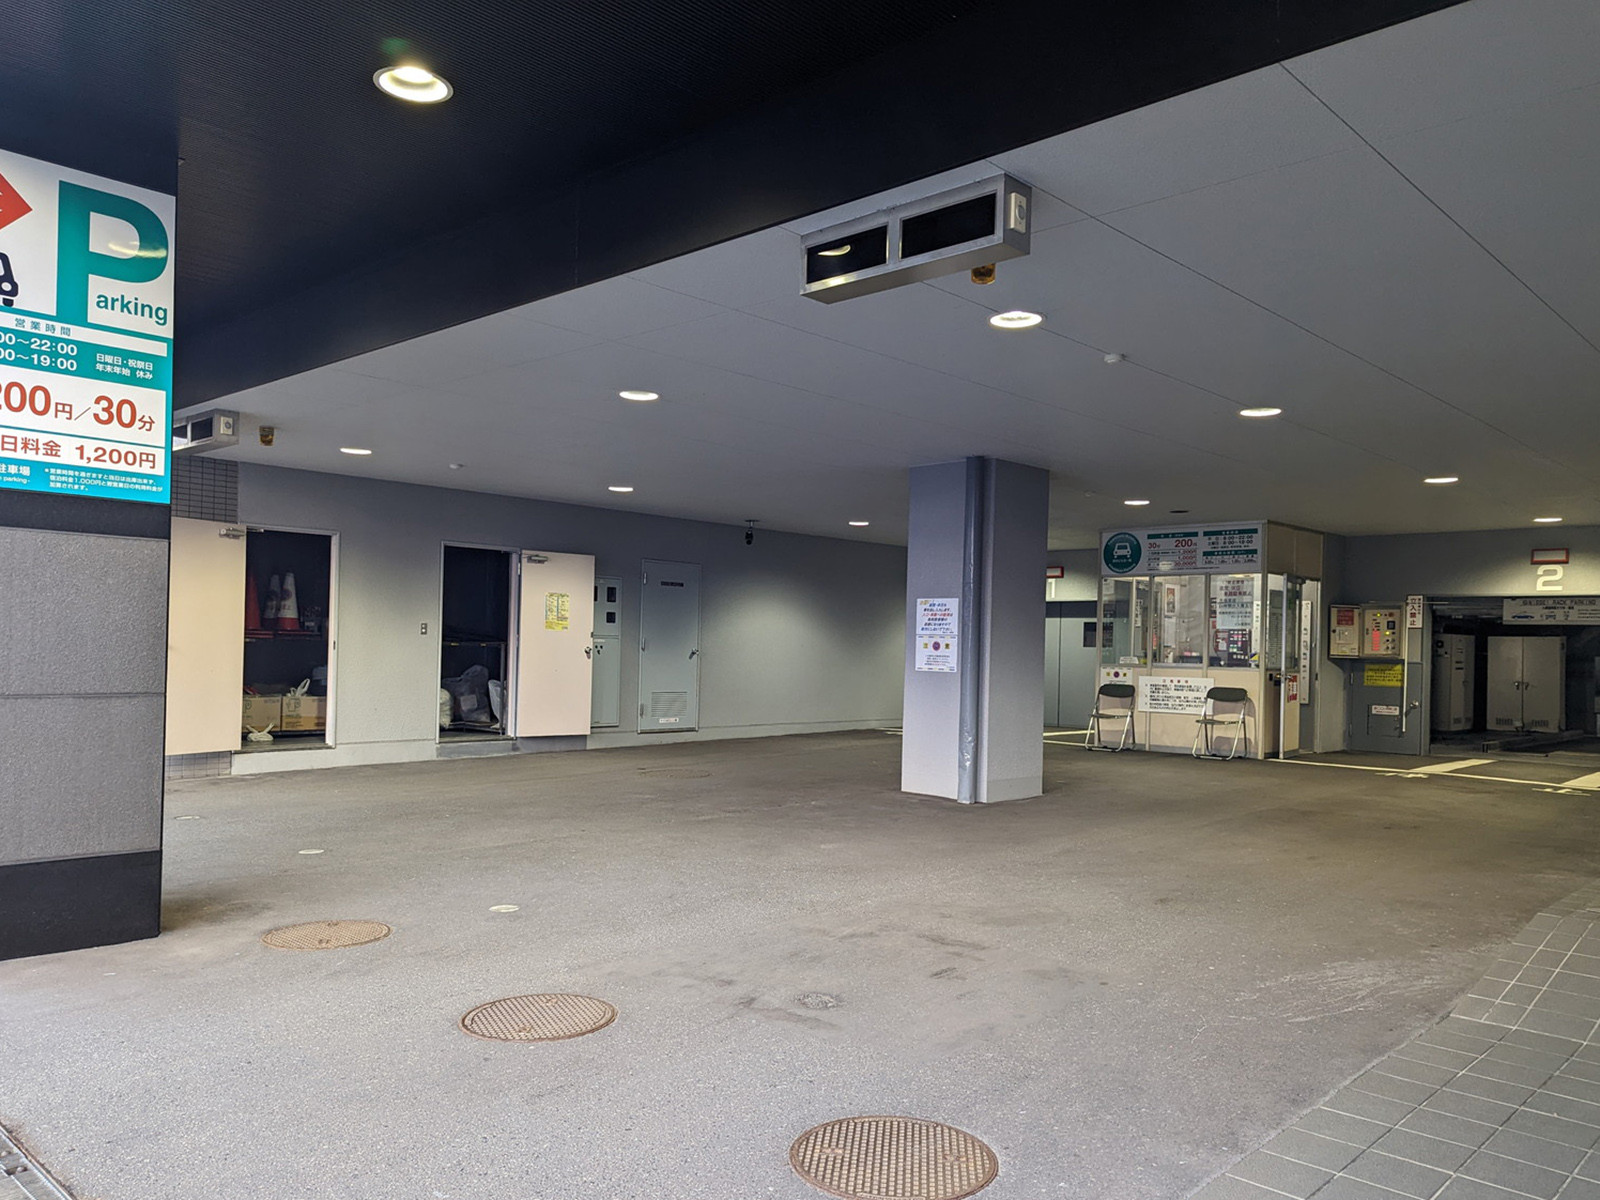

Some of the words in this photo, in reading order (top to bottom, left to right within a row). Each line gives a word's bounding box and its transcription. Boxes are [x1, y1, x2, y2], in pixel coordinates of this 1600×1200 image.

[14, 318, 71, 337] 営業時間
[95, 363, 131, 377] 年末年始
[135, 368, 153, 380] 休み
[75, 444, 156, 470] 1,200円
[1536, 565, 1564, 591] 2
